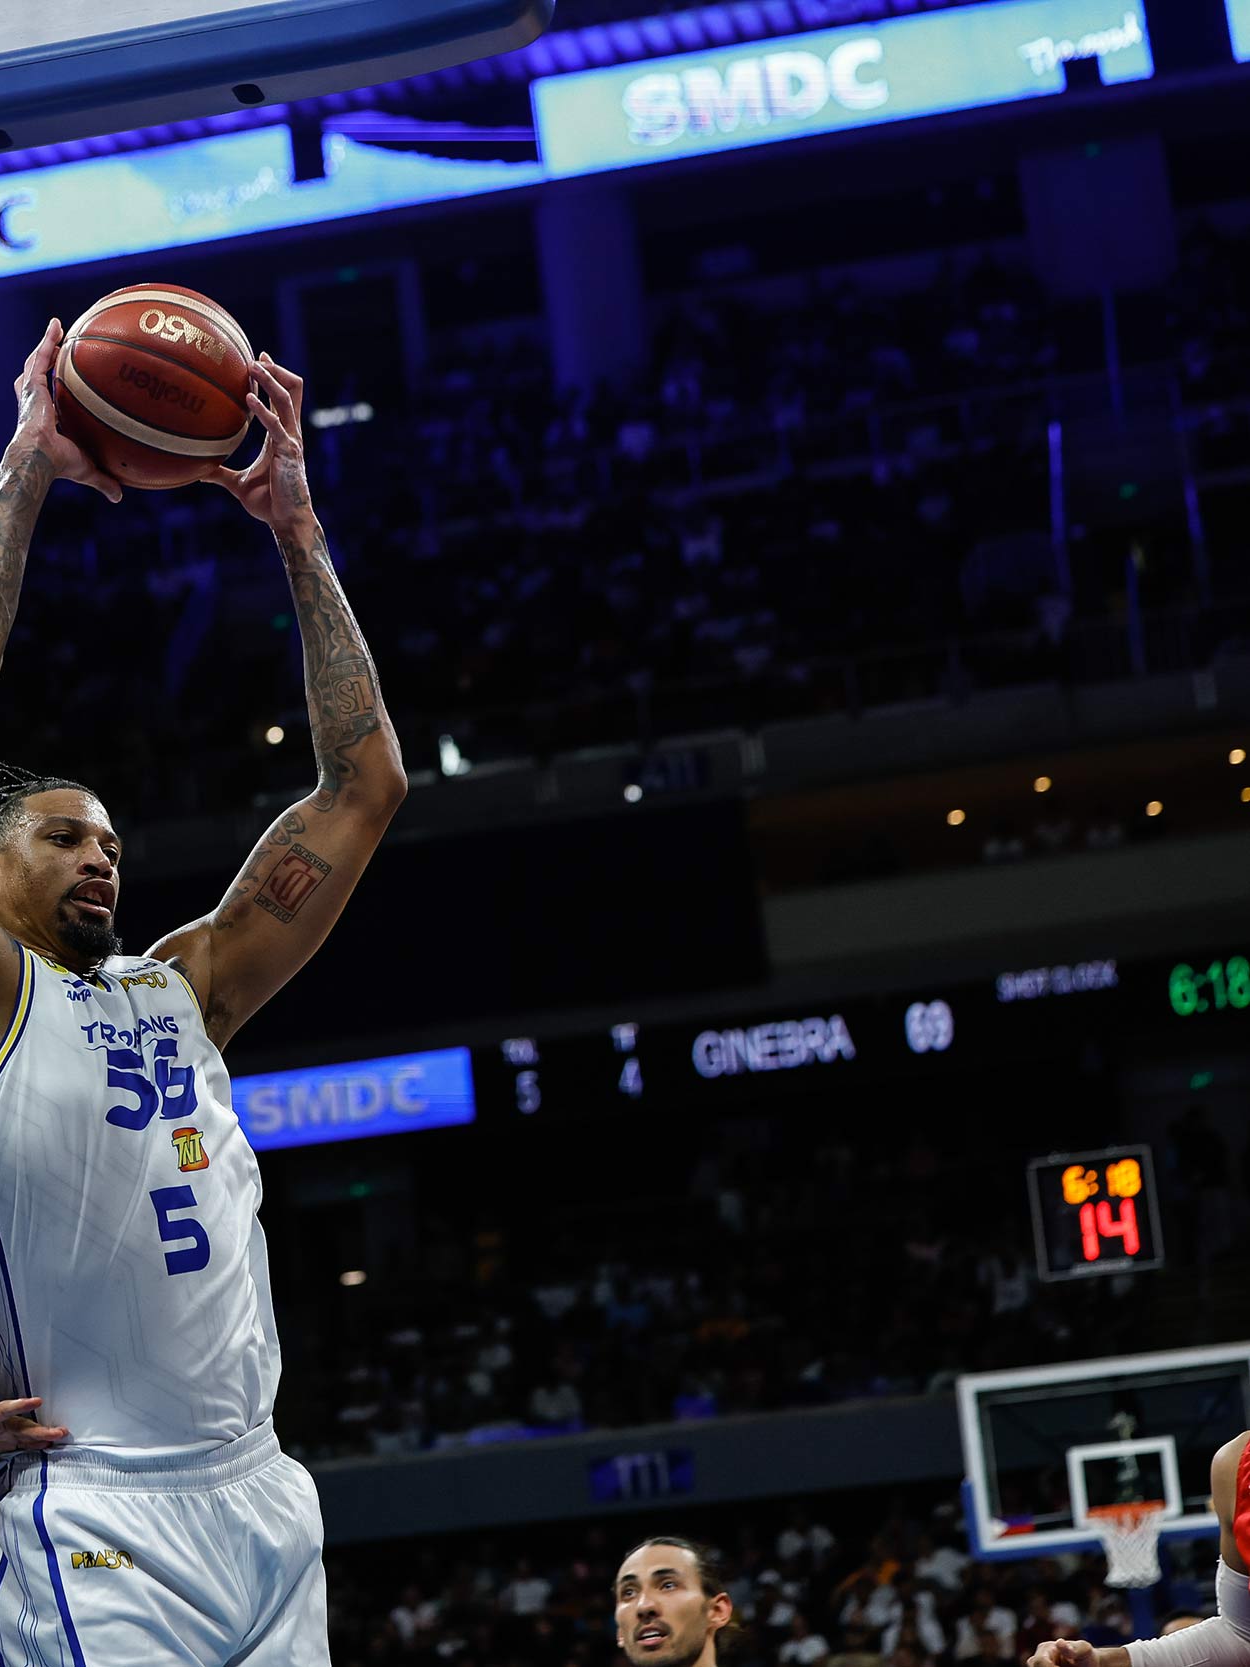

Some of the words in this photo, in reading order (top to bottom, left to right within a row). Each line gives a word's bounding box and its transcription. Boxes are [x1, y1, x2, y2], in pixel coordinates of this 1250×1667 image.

[622, 38, 889, 146] SMDC
[118, 361, 207, 416] molten
[67, 988, 92, 1002] ANTA
[692, 1014, 856, 1078] GINEBRA
[249, 1066, 429, 1134] SMDC
[172, 1132, 203, 1169] TNT
[150, 1185, 211, 1276] 5
[1080, 1198, 1140, 1260] 14
[70, 1549, 134, 1570] PBA50
